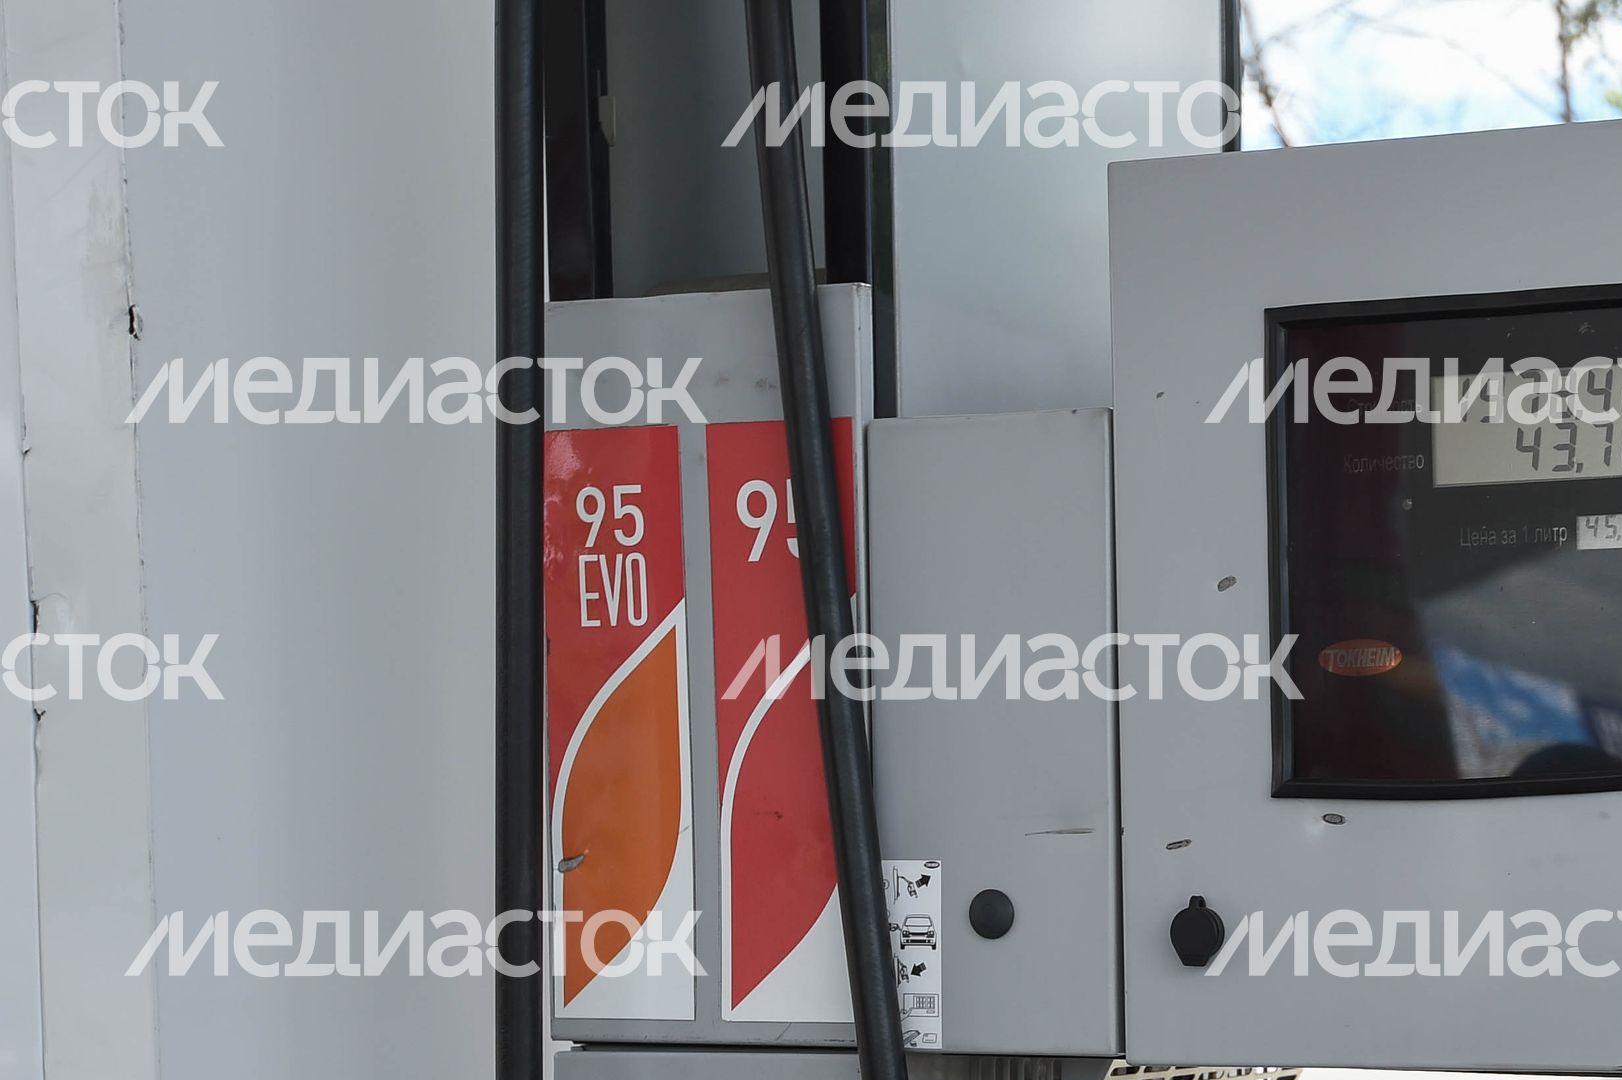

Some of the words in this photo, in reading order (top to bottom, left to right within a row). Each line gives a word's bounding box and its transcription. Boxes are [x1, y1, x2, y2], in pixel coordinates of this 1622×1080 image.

[575, 484, 644, 547] 95
[1459, 526, 1496, 548] Цена
[1501, 529, 1516, 545] за
[1534, 525, 1568, 546] литр
[578, 551, 648, 629] EVO
[1321, 646, 1396, 672] TOKHEIM
